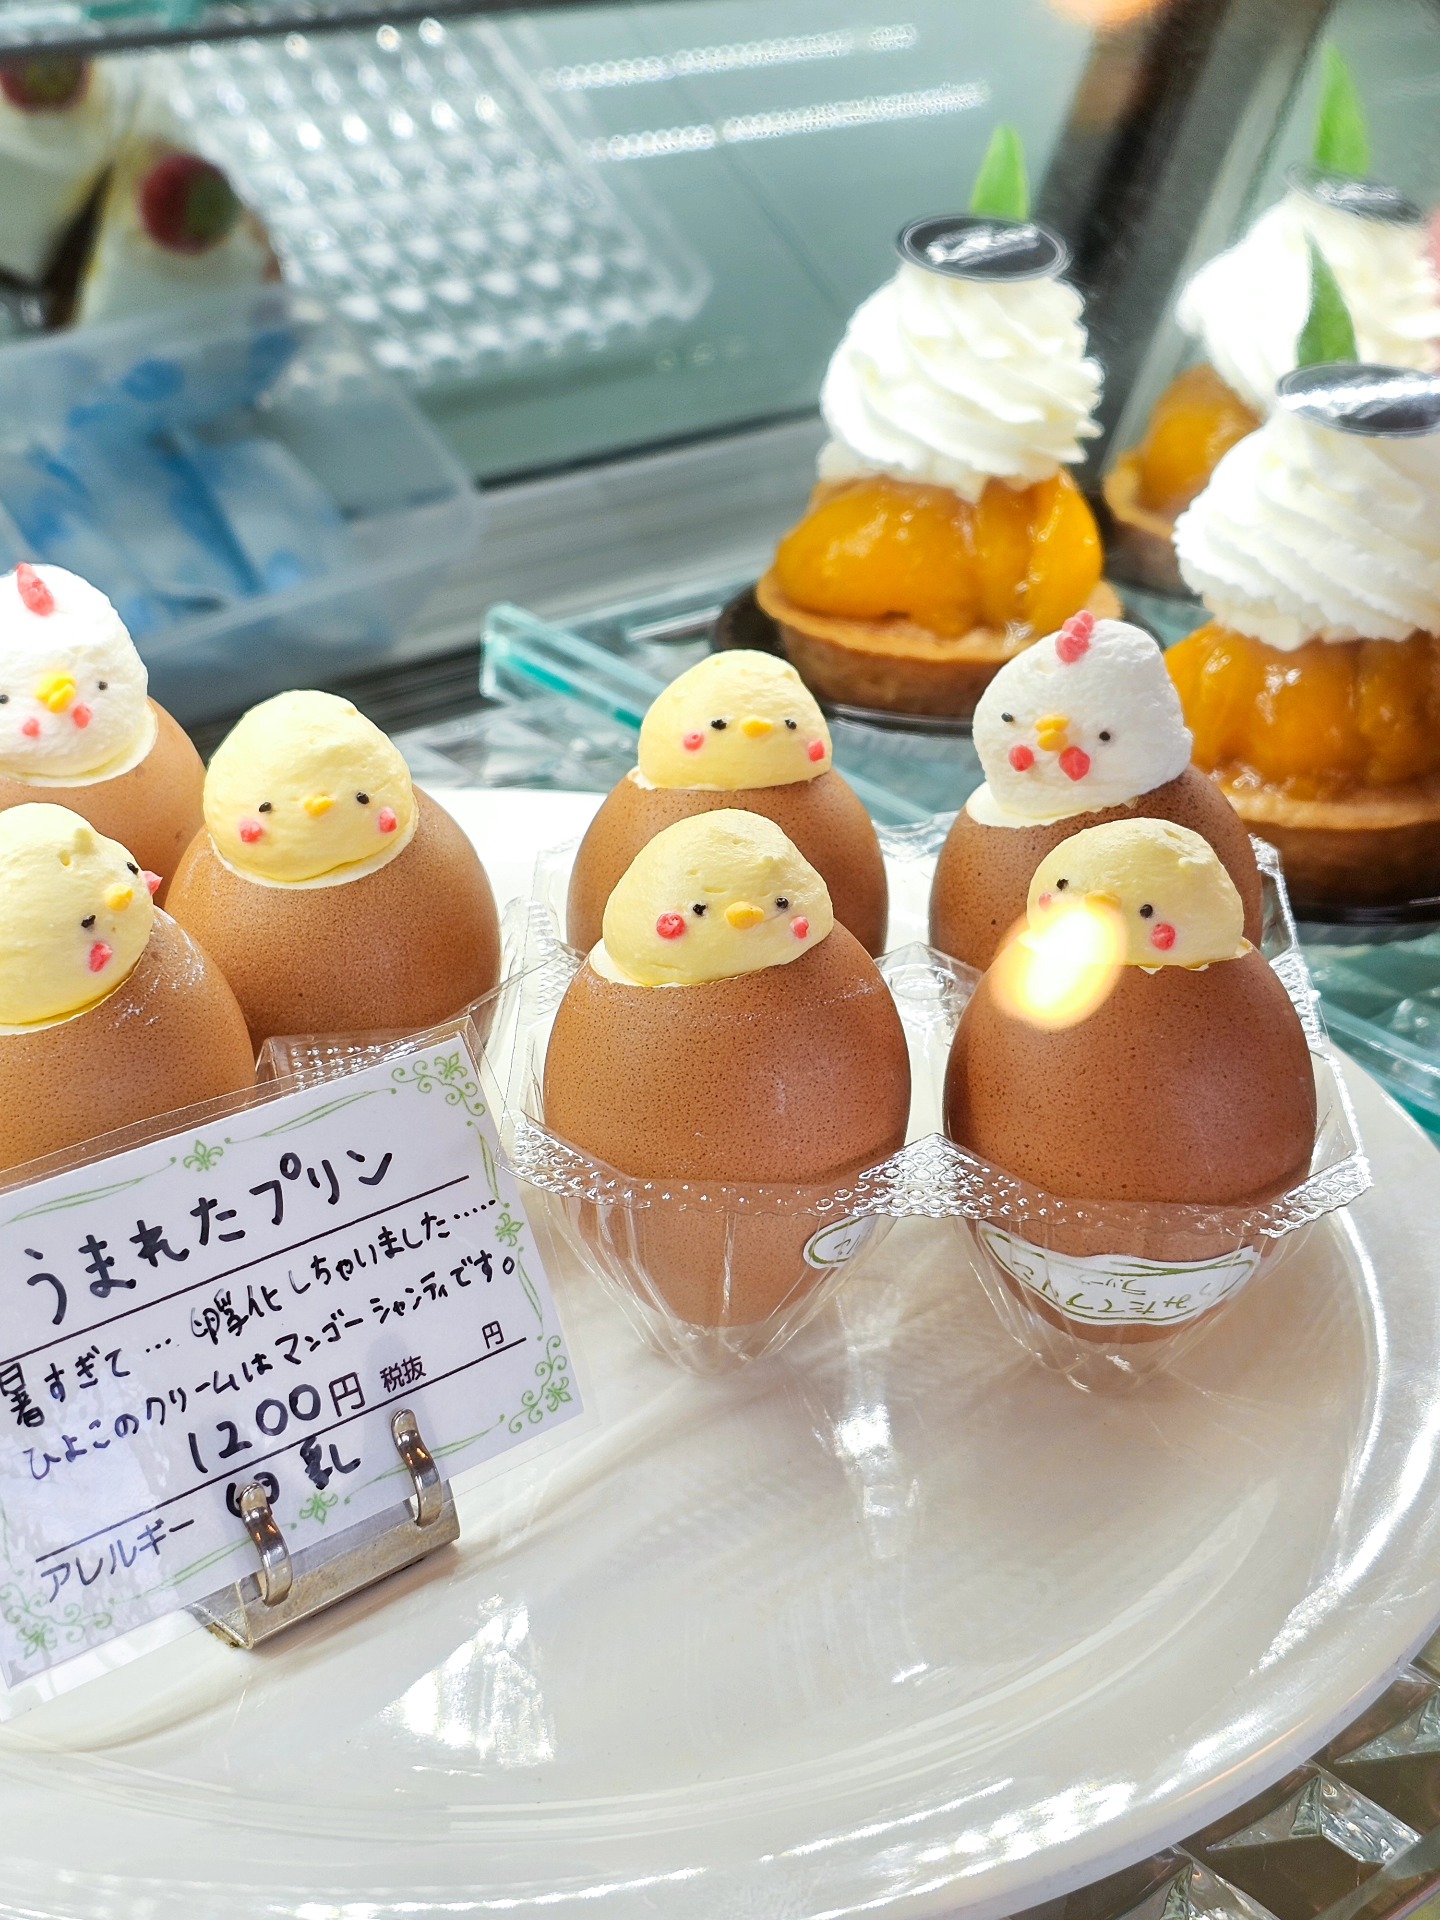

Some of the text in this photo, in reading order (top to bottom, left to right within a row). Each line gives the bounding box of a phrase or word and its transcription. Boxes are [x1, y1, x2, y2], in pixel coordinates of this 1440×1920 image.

[25, 1151, 393, 1325] うまれたプリン
[188, 1320, 505, 1474] 1200円 税抜 円
[40, 1517, 195, 1603] アレルギー
